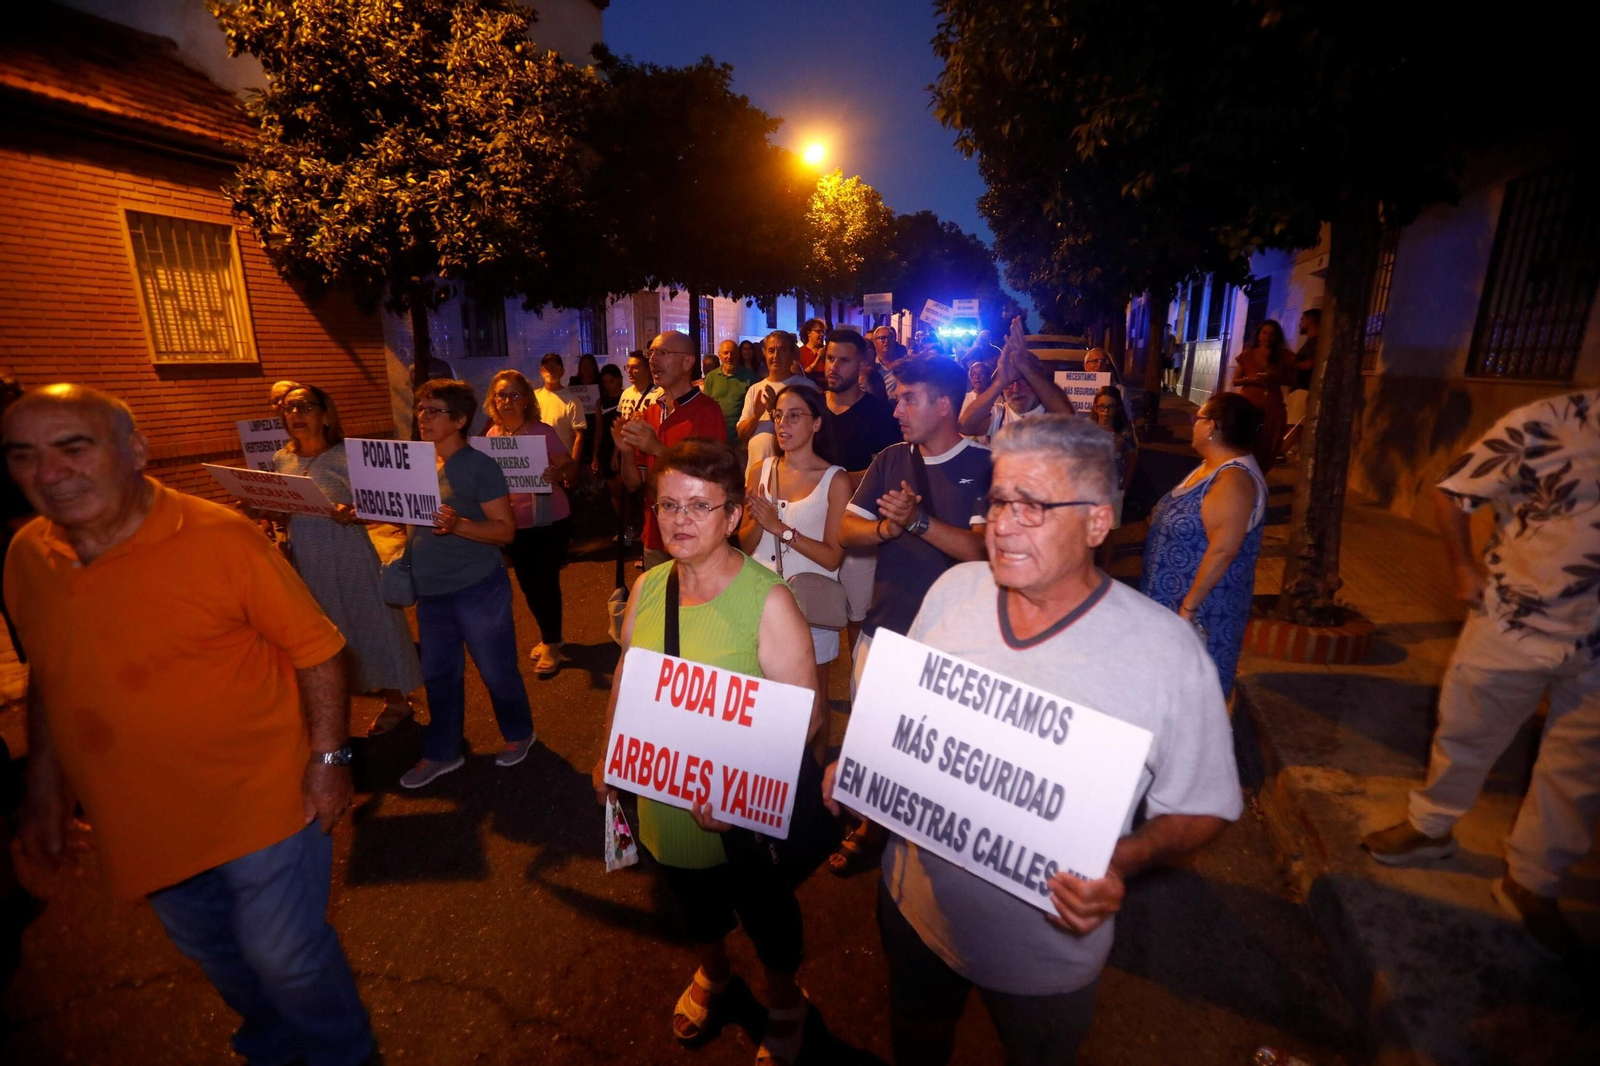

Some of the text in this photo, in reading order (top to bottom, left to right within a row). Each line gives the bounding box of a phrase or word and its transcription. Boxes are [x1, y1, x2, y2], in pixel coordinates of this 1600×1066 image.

[1066, 373, 1097, 381] NECESITAMOS
[249, 419, 274, 432] LIMPIEZA
[244, 440, 275, 453] VERTEDERO
[362, 441, 411, 470] PODA DE
[490, 437, 518, 450] FUERA
[230, 469, 288, 486] QUEREMOS
[240, 484, 305, 501] MEJORAS EN
[355, 488, 404, 518] ARBOLES
[655, 657, 760, 727] PODA DE
[918, 652, 1073, 746] NECESITAMOS
[608, 733, 789, 828] ARBOLES YA!!!!!
[892, 715, 1066, 822] MÁS SEGURIDAD
[838, 757, 1059, 897] EN NUESTRAS CALLES
